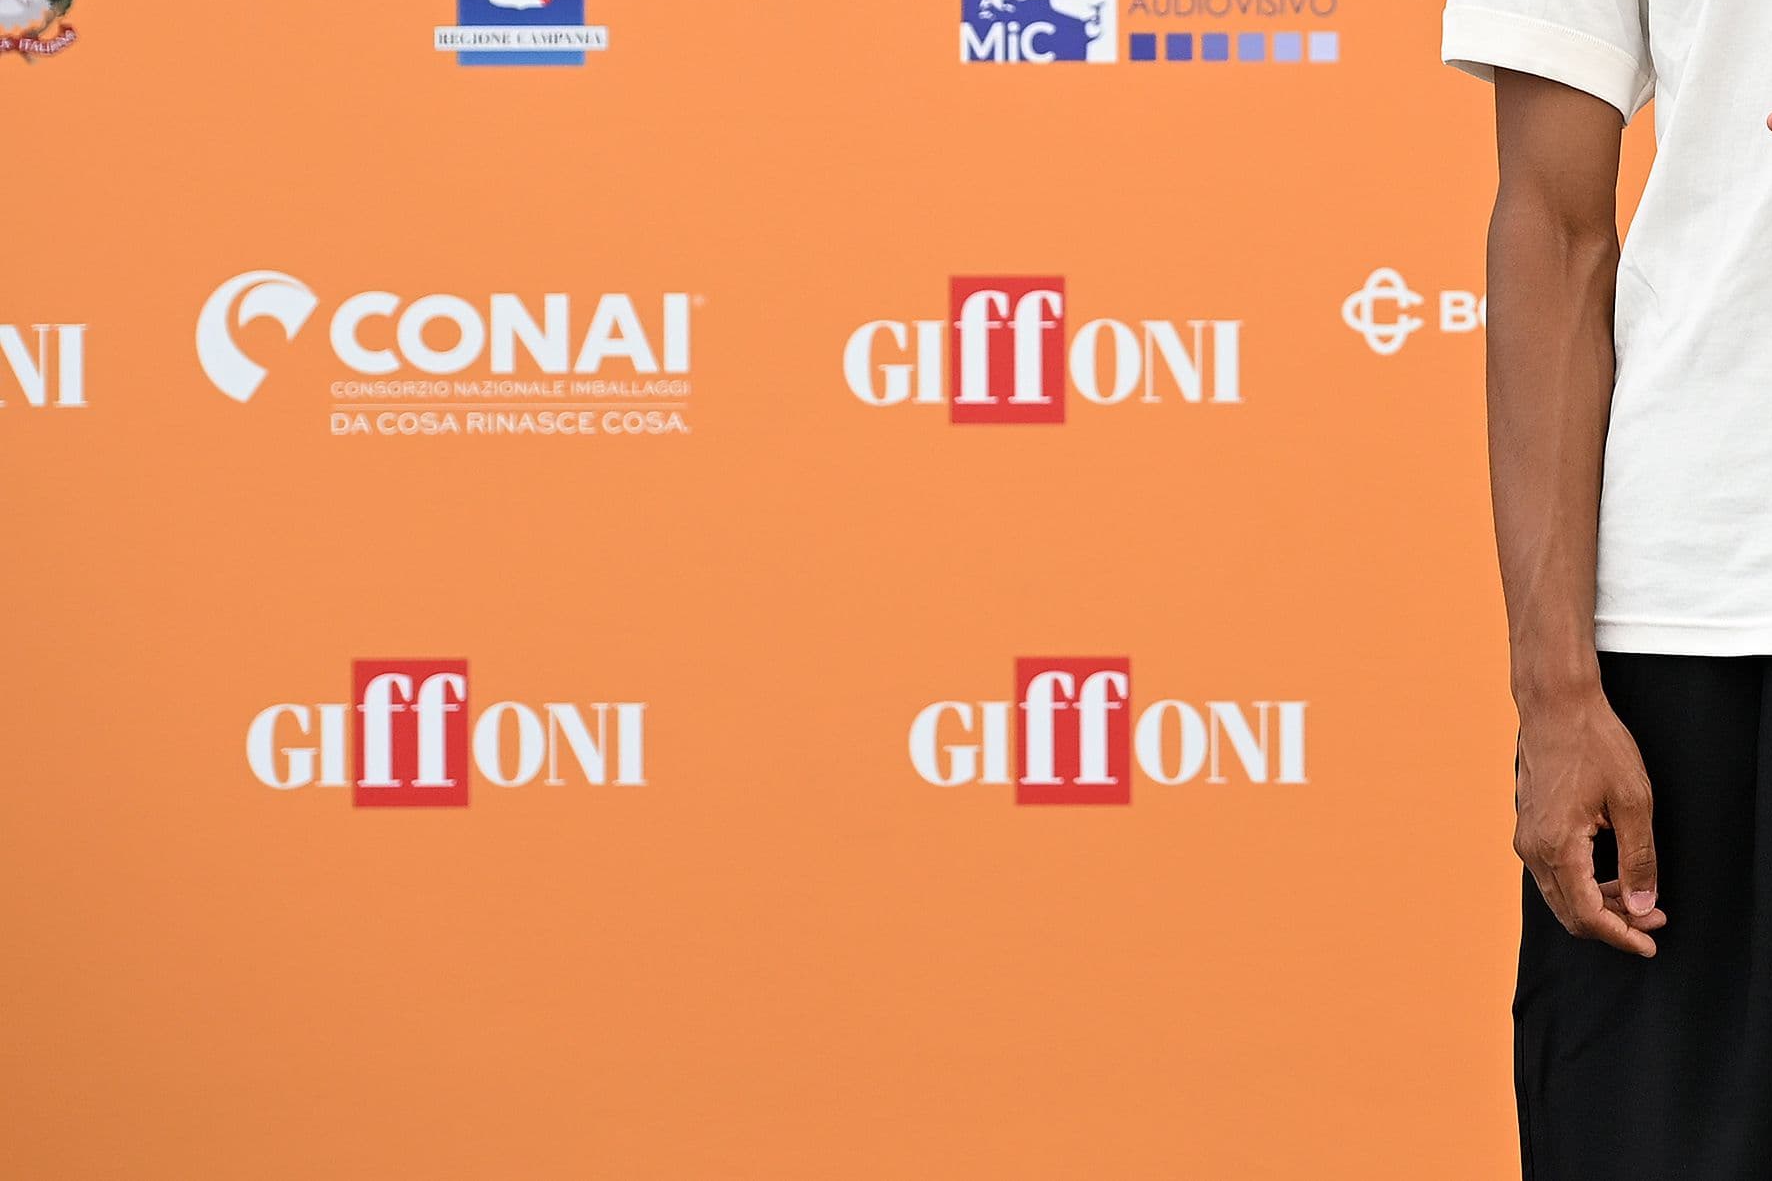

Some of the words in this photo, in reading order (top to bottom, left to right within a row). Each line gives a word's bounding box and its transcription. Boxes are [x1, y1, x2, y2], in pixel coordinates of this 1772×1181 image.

[438, 32, 511, 44] REGIONE
[516, 32, 602, 44] CAMPANIA
[960, 21, 1056, 62] MiC
[330, 291, 691, 375] CONAI
[844, 291, 1243, 407] GIffONI
[331, 381, 449, 397] CONSORZIO
[454, 381, 564, 397] NAZIONALE
[571, 380, 691, 396] IMBALLAGGI
[330, 412, 371, 435] DA
[376, 412, 460, 435] COSA
[467, 411, 596, 435] RINASCE
[602, 411, 691, 435] COSA.
[247, 674, 647, 791] GIffONI
[909, 672, 1309, 788] GIffONI
